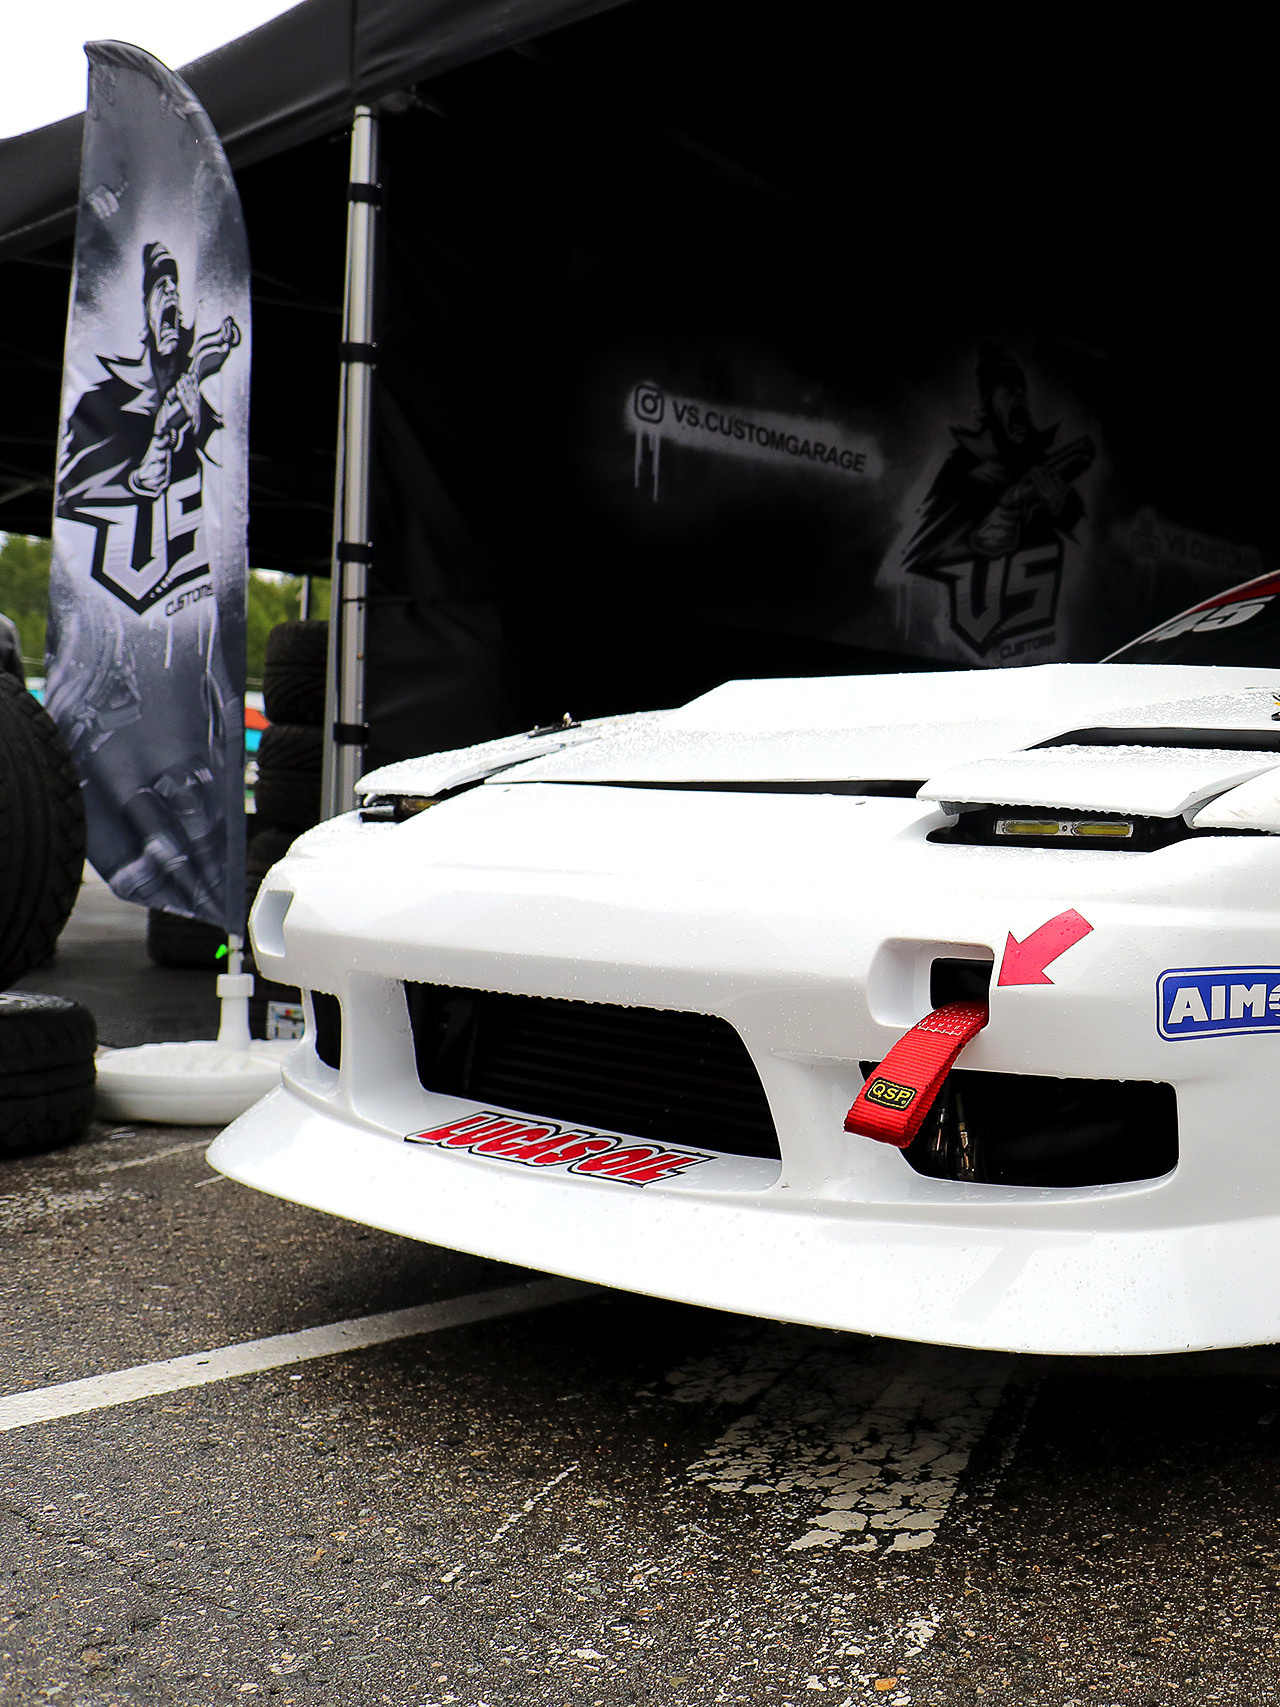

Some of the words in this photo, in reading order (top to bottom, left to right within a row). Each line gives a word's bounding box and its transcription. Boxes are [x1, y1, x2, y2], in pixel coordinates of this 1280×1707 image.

[672, 400, 868, 473] VS.CUSTOMGARAGE
[873, 1084, 911, 1101] QSP
[410, 1113, 617, 1166] LUCAS
[572, 1146, 704, 1184] OIL
